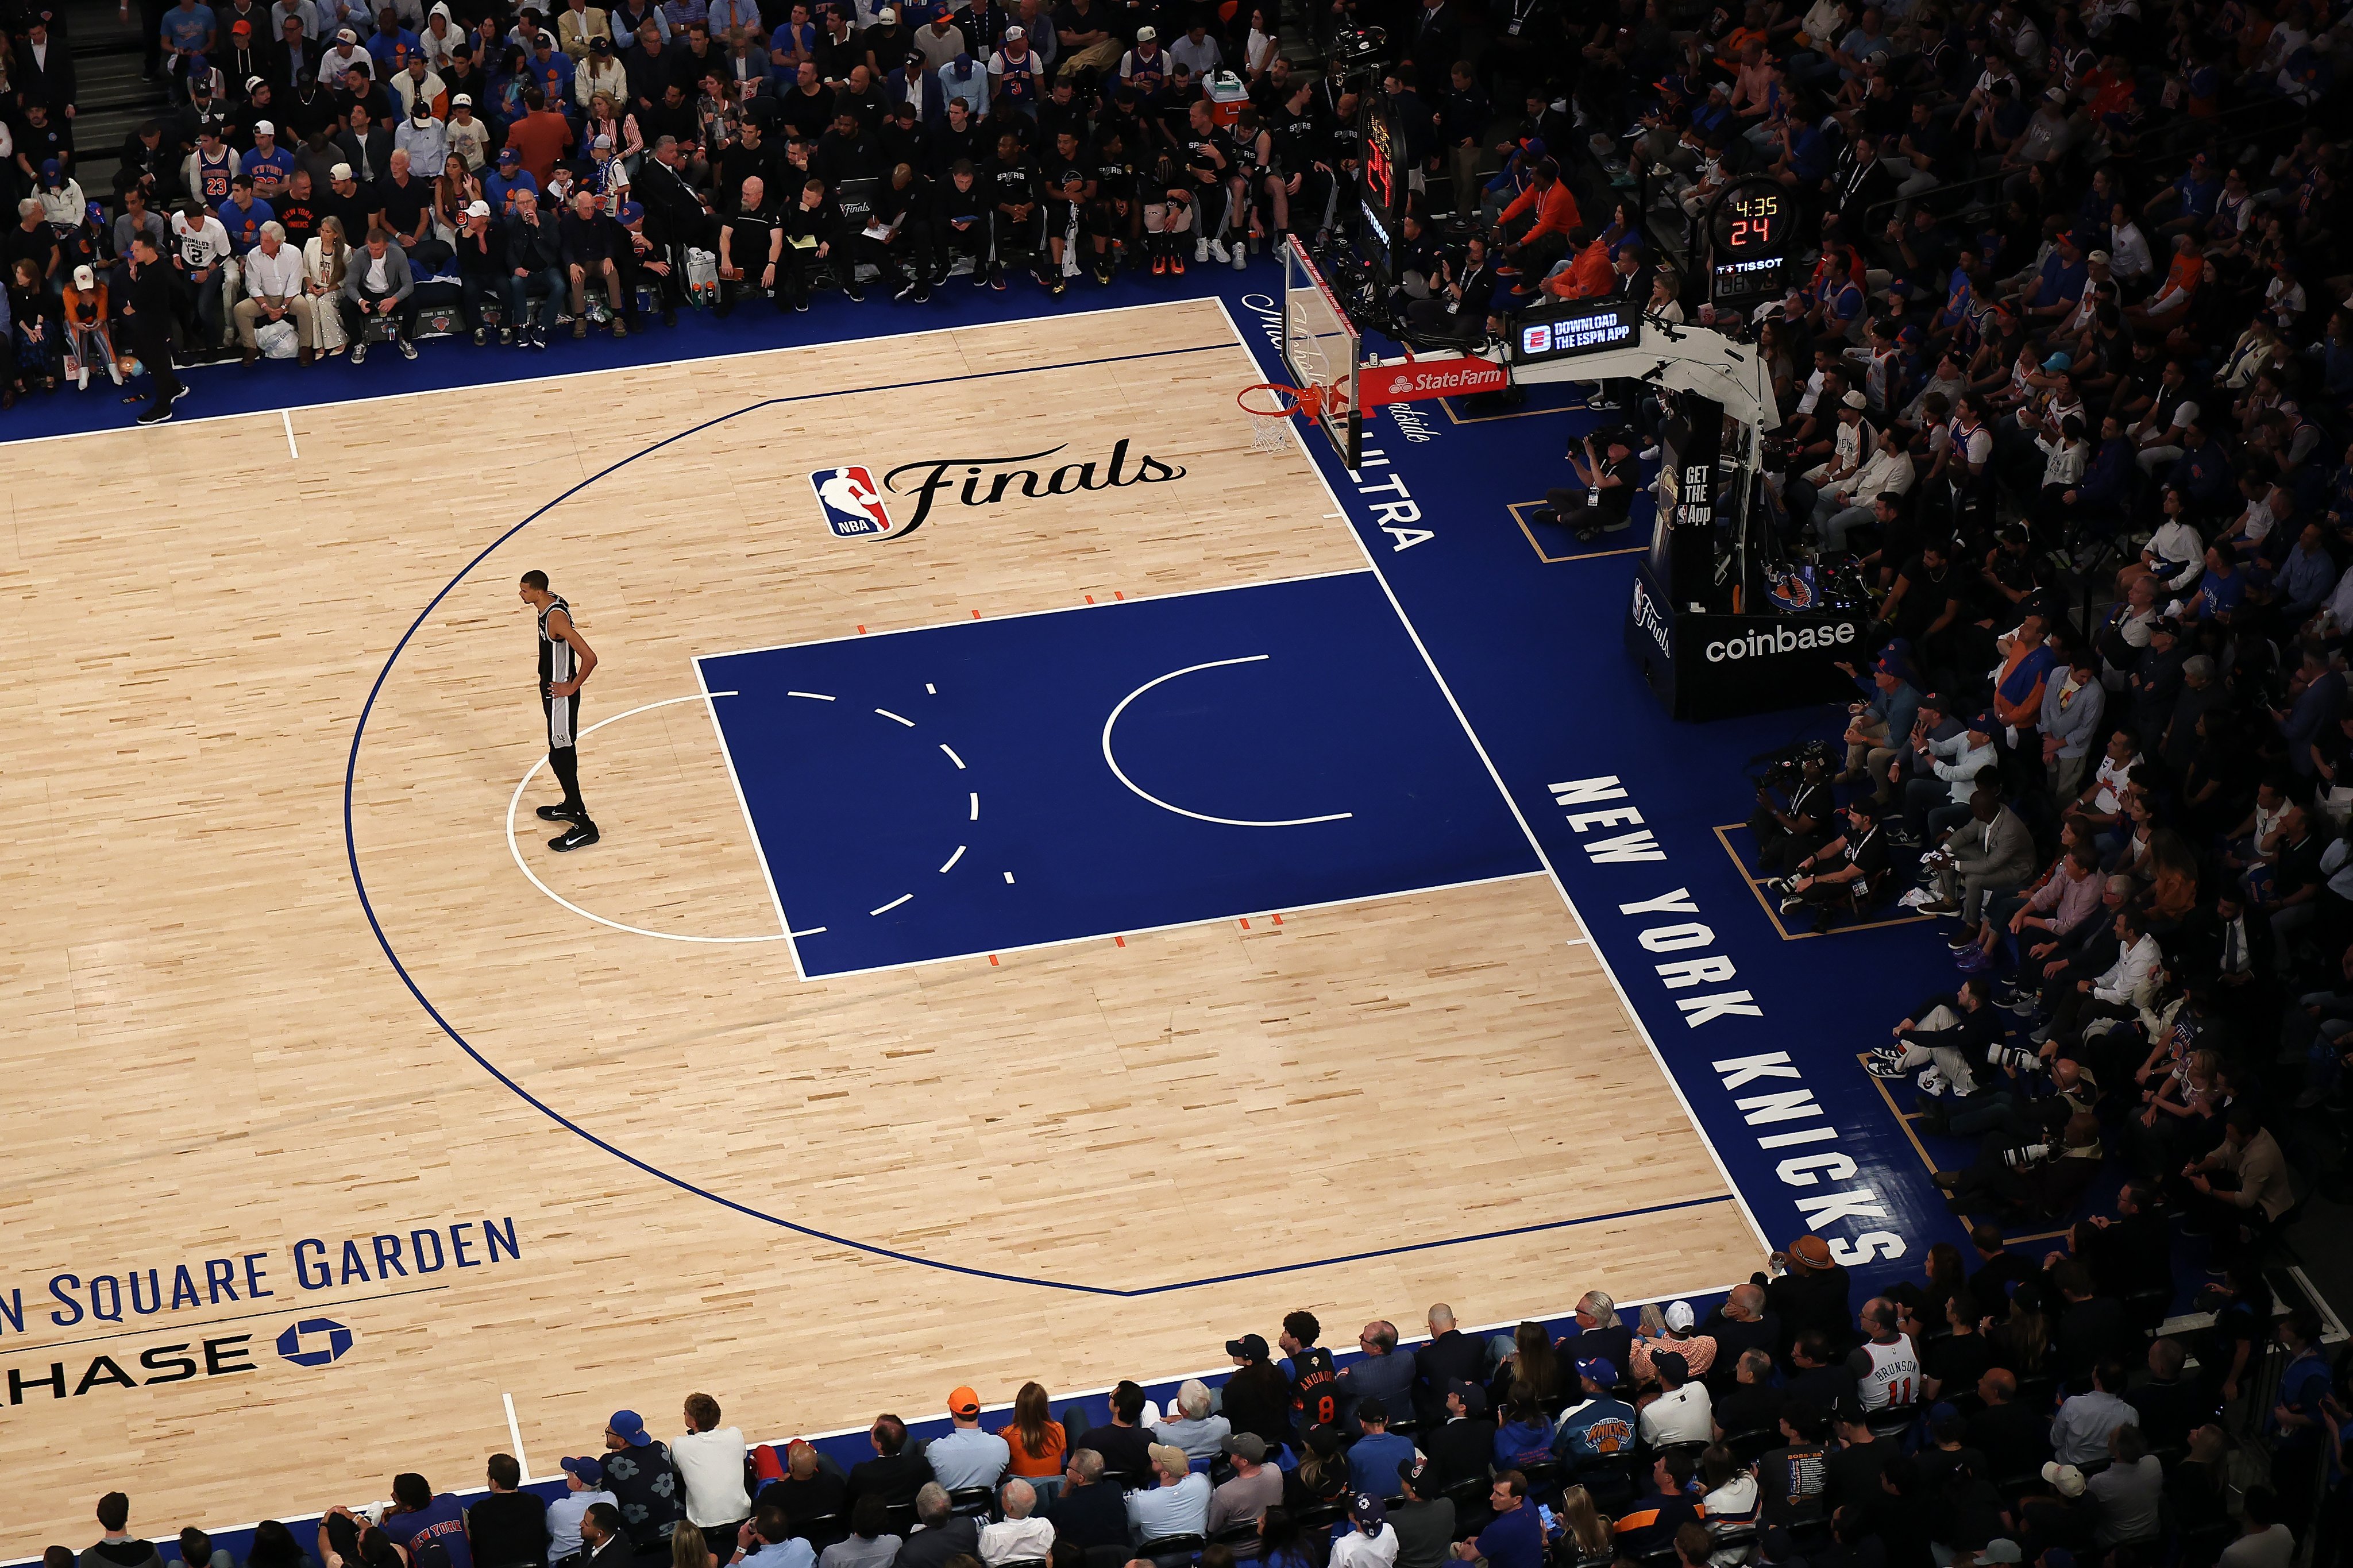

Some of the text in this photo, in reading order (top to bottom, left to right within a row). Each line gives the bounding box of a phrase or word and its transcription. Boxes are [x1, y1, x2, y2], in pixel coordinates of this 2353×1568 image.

[1011, 80, 1021, 95] 3
[207, 178, 227, 195] 23
[844, 202, 870, 218] Finals
[1737, 196, 1777, 217] 4:35
[1731, 218, 1769, 246] 24
[191, 249, 203, 262] 2
[1735, 258, 1783, 272] TISSOT
[1554, 314, 1617, 335] DOWNLOAD
[1555, 325, 1630, 349] THE ESPN APP
[1388, 403, 1442, 443] rtside
[1685, 465, 1709, 484] GET
[867, 438, 1187, 543] Finals
[1685, 485, 1708, 503] THE
[1683, 504, 1711, 526] App
[838, 519, 870, 534] NBA
[1635, 593, 1670, 659] Finals
[1706, 622, 1856, 662] coinbase
[1547, 775, 1907, 1267] NEW YORK KNICKS
[49, 1253, 274, 1326] SQUARE
[294, 1217, 520, 1290] GARDEN
[0, 1334, 259, 1407] HASE
[1875, 1361, 1917, 1381] BRUNSON
[1887, 1377, 1911, 1406] 11
[1318, 1395, 1334, 1424] 8
[1587, 1422, 1630, 1443] KNICKS
[410, 1520, 462, 1551] NEW YORK
